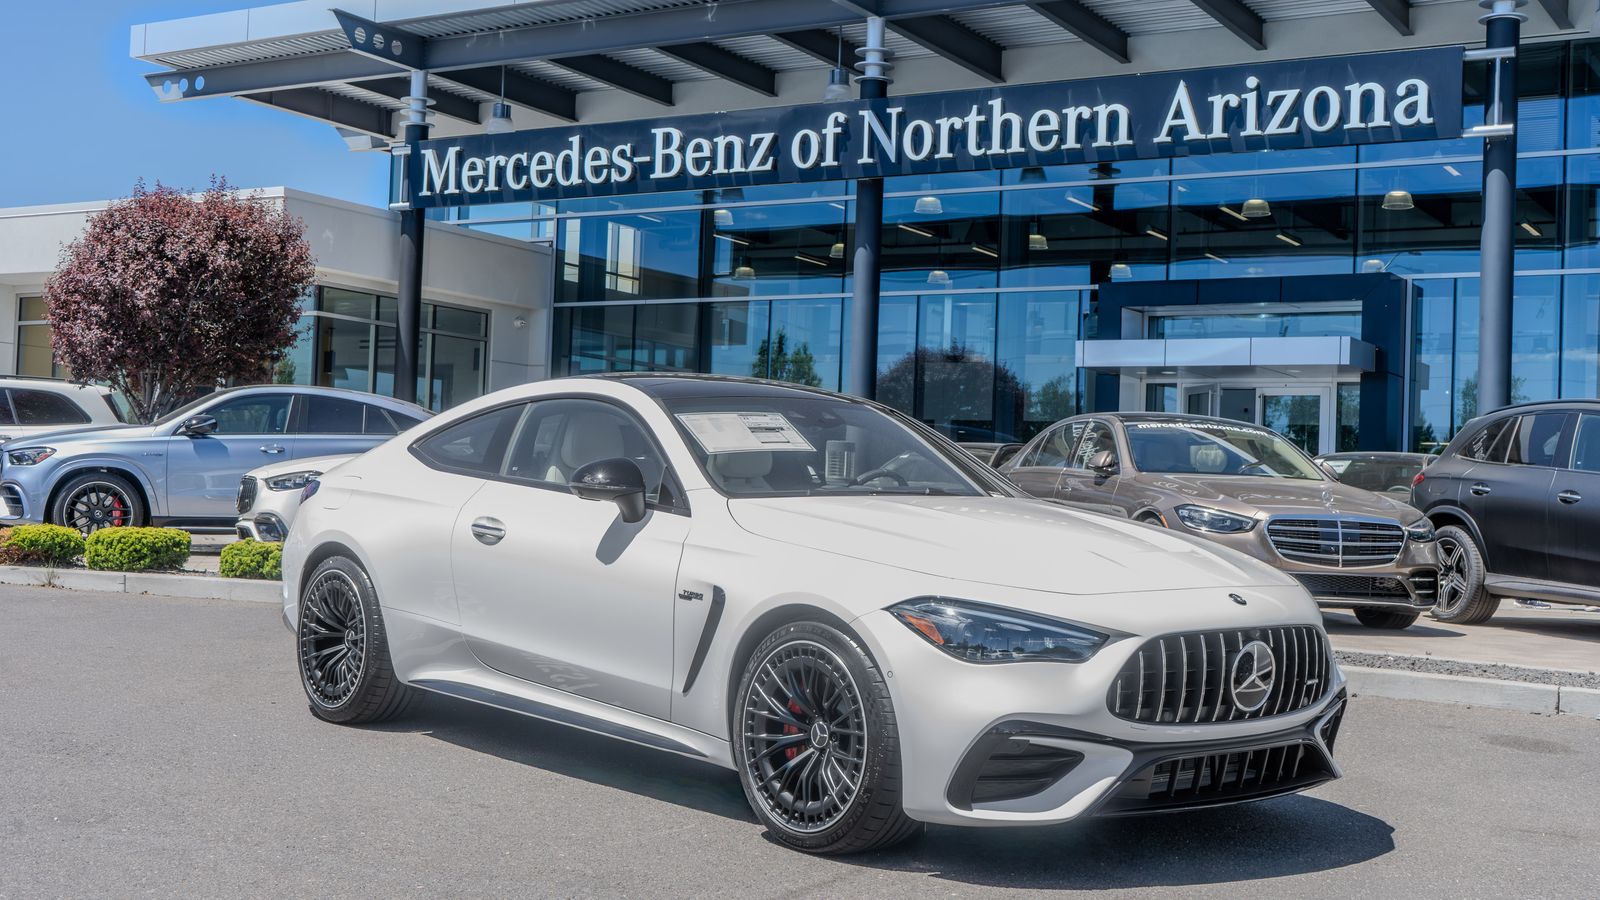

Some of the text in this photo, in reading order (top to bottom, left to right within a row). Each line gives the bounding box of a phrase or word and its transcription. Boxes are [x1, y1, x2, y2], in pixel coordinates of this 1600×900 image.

[418, 75, 1434, 197] Mercedes-Benz of Northern Arizona
